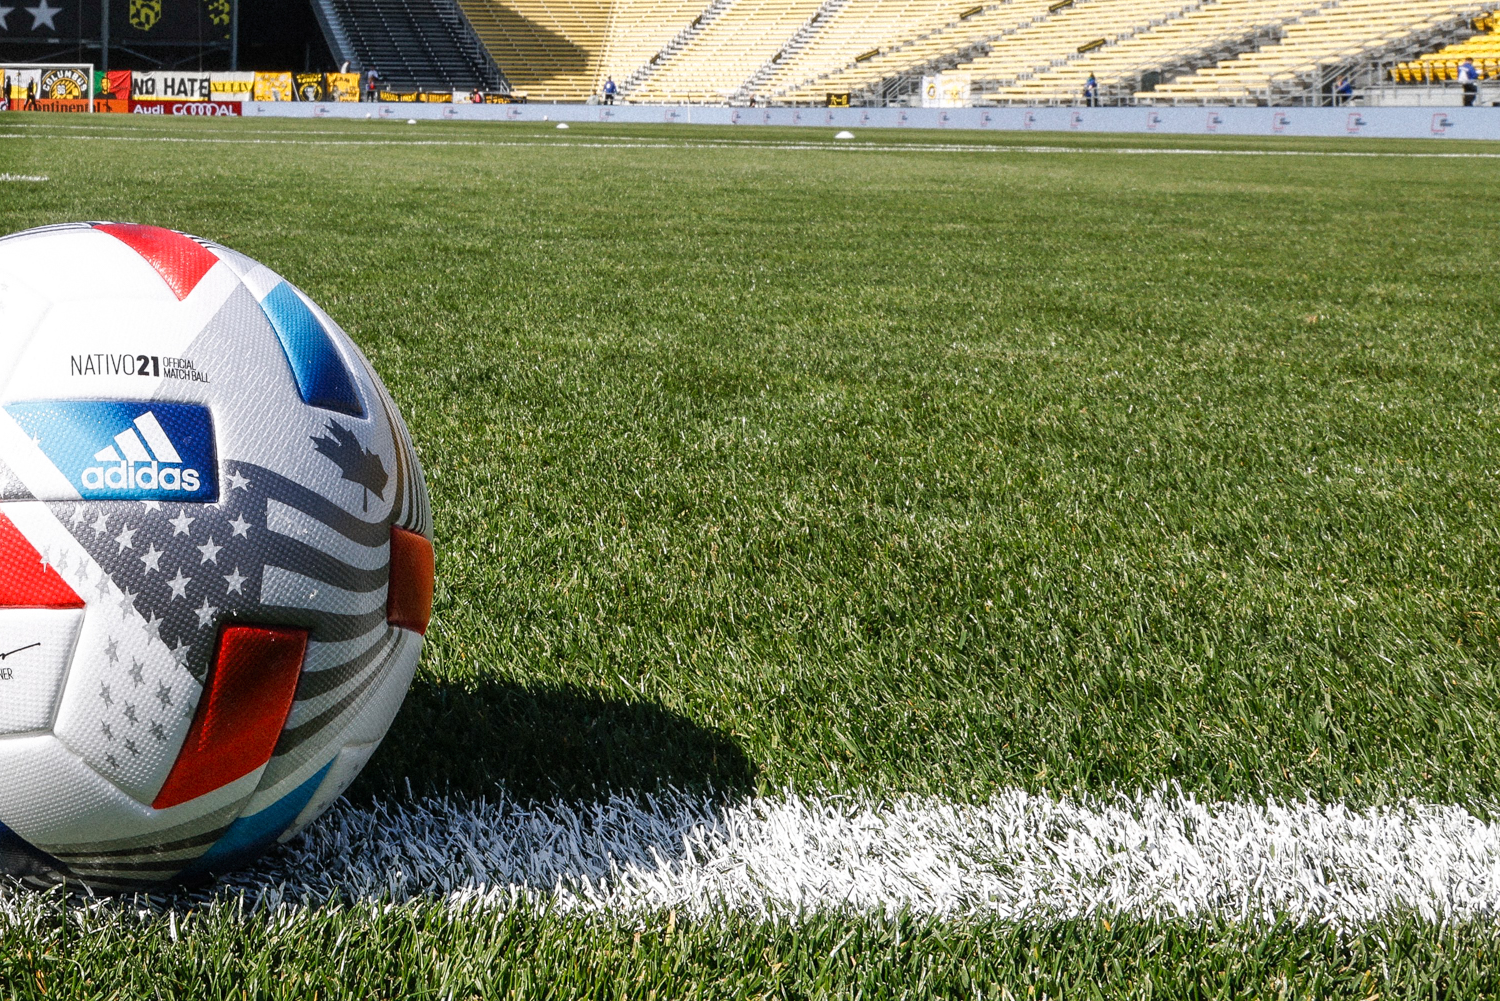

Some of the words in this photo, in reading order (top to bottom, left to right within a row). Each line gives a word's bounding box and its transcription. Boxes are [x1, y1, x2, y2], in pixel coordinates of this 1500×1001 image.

[42, 70, 88, 92] COLUMBUS
[133, 78, 155, 95] NO
[164, 77, 211, 97] HATE
[133, 104, 165, 115] Audi
[162, 356, 197, 371] OFFICIAL
[163, 367, 191, 381] MATCH
[191, 372, 211, 384] BALL
[81, 459, 201, 492] adidas
